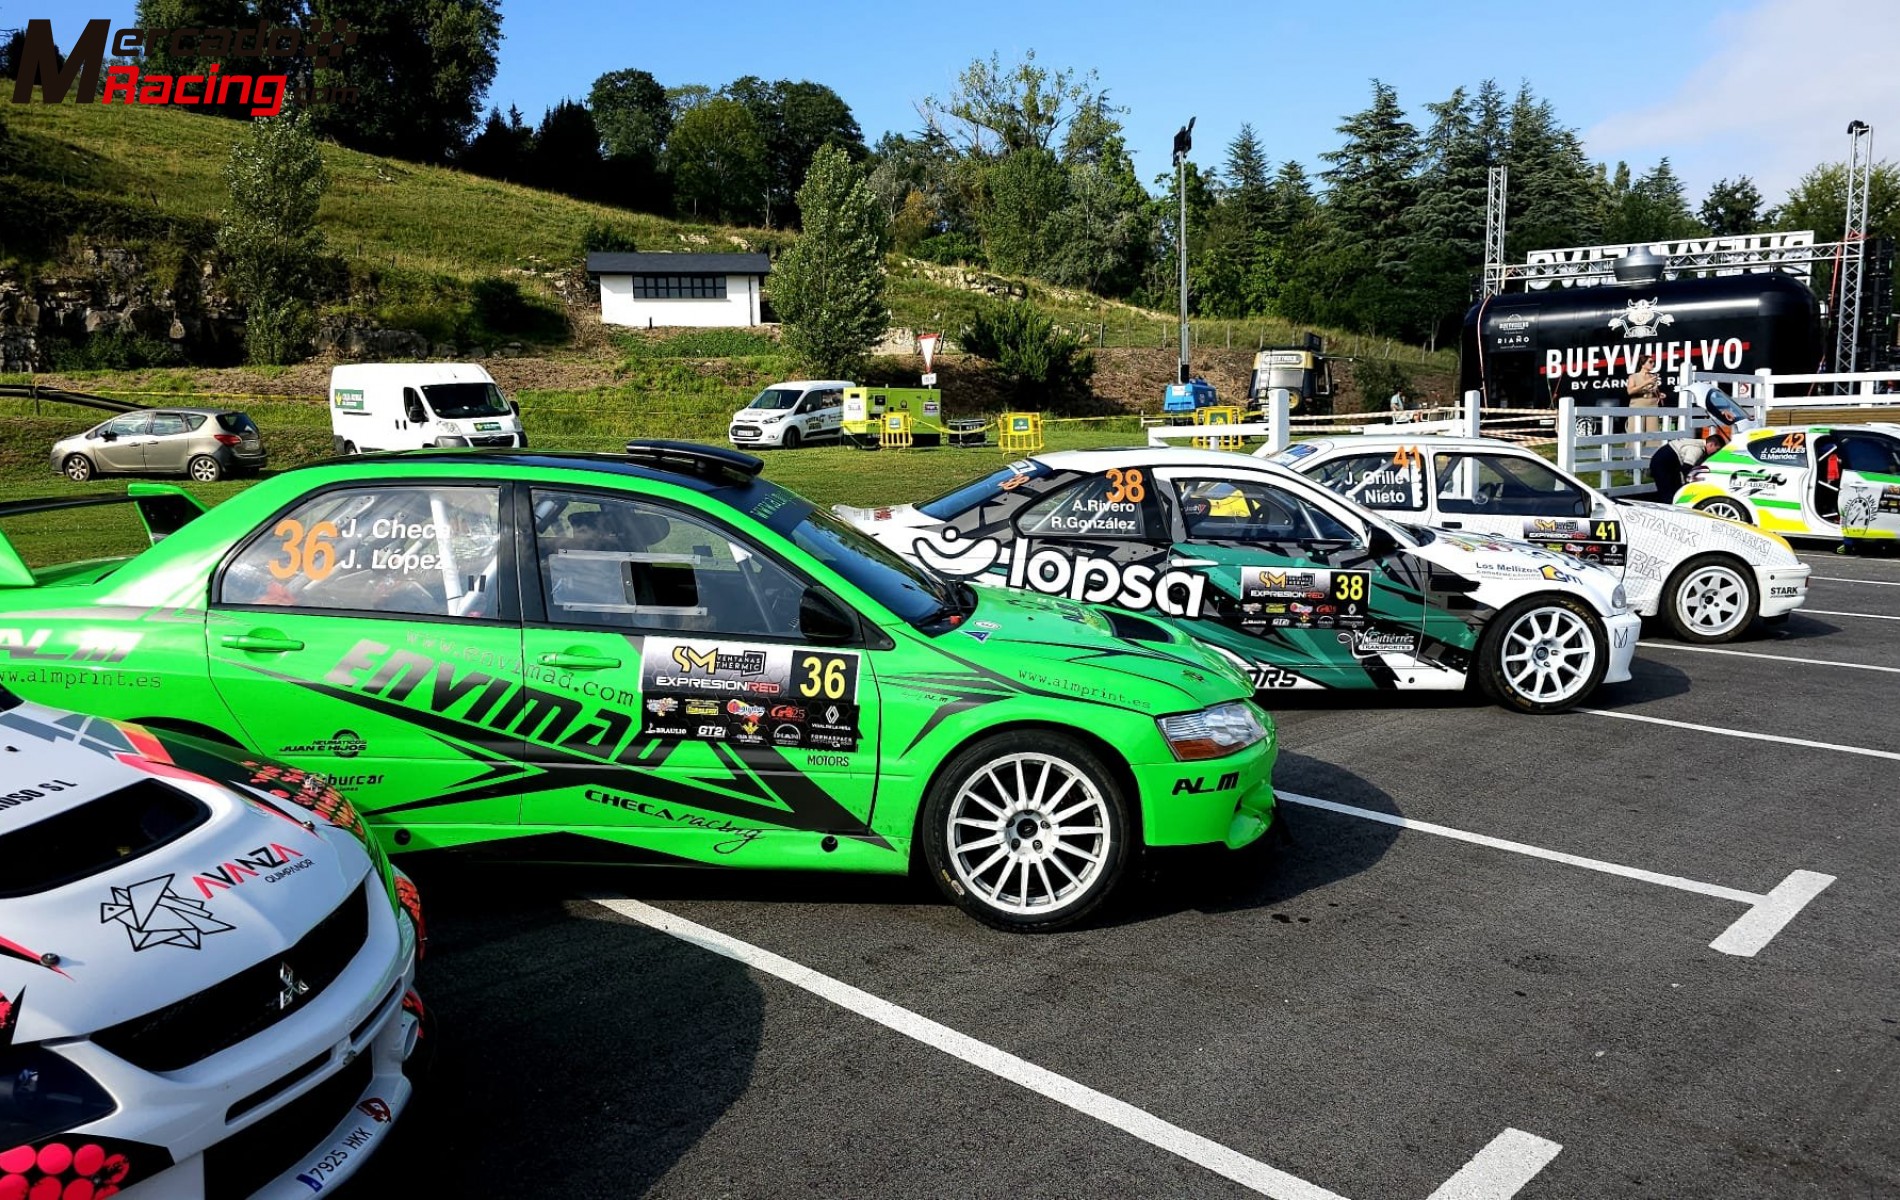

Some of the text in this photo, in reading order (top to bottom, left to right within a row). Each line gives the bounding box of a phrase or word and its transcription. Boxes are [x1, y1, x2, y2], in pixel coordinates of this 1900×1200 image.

[1546, 337, 1744, 379] BUEYVUELVO
[1571, 381, 1589, 390] BY
[1782, 433, 1805, 449] 42
[1393, 445, 1421, 469] 41
[1105, 468, 1146, 504] 38
[1344, 471, 1358, 485] J.
[1072, 499, 1135, 514] A.Rivero
[1365, 489, 1406, 504] Nieto
[342, 518, 362, 539] J.
[1051, 515, 1137, 532] R.González
[1595, 521, 1617, 541] 41
[269, 519, 338, 581] 36
[341, 548, 449, 575] J. López
[1336, 574, 1364, 600] 38
[1770, 586, 1799, 595] STARK
[717, 653, 762, 665] VENTANAS
[672, 645, 847, 699] SM 36
[1019, 669, 1152, 709] www.almprint.es
[807, 754, 849, 766] MOTORS
[323, 773, 385, 786] burcar
[192, 843, 304, 899] AVANZA
[264, 858, 316, 884] QUIMPANOR
[308, 1127, 373, 1181] 7925 HKK
